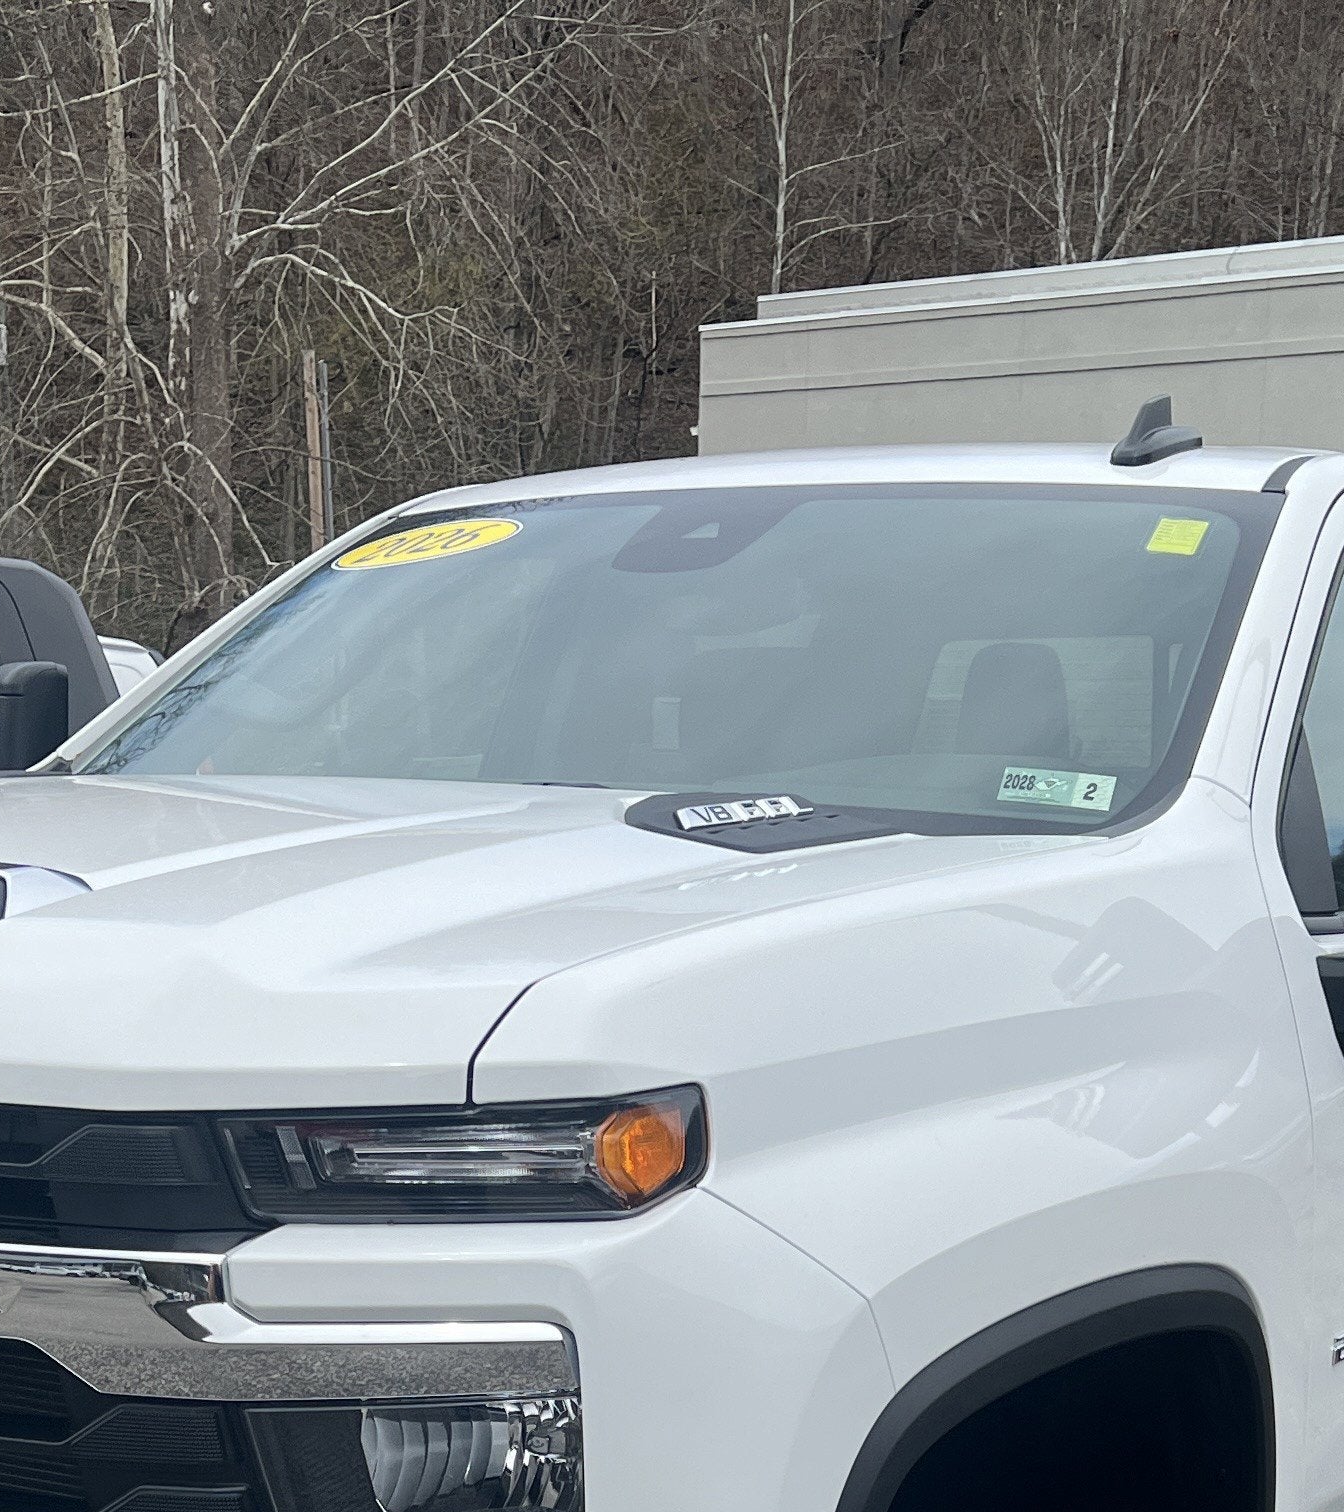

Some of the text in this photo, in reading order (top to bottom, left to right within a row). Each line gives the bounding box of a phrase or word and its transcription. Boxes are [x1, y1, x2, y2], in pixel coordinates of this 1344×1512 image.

[1003, 773, 1098, 801] 2028 2
[689, 804, 733, 823] V8
